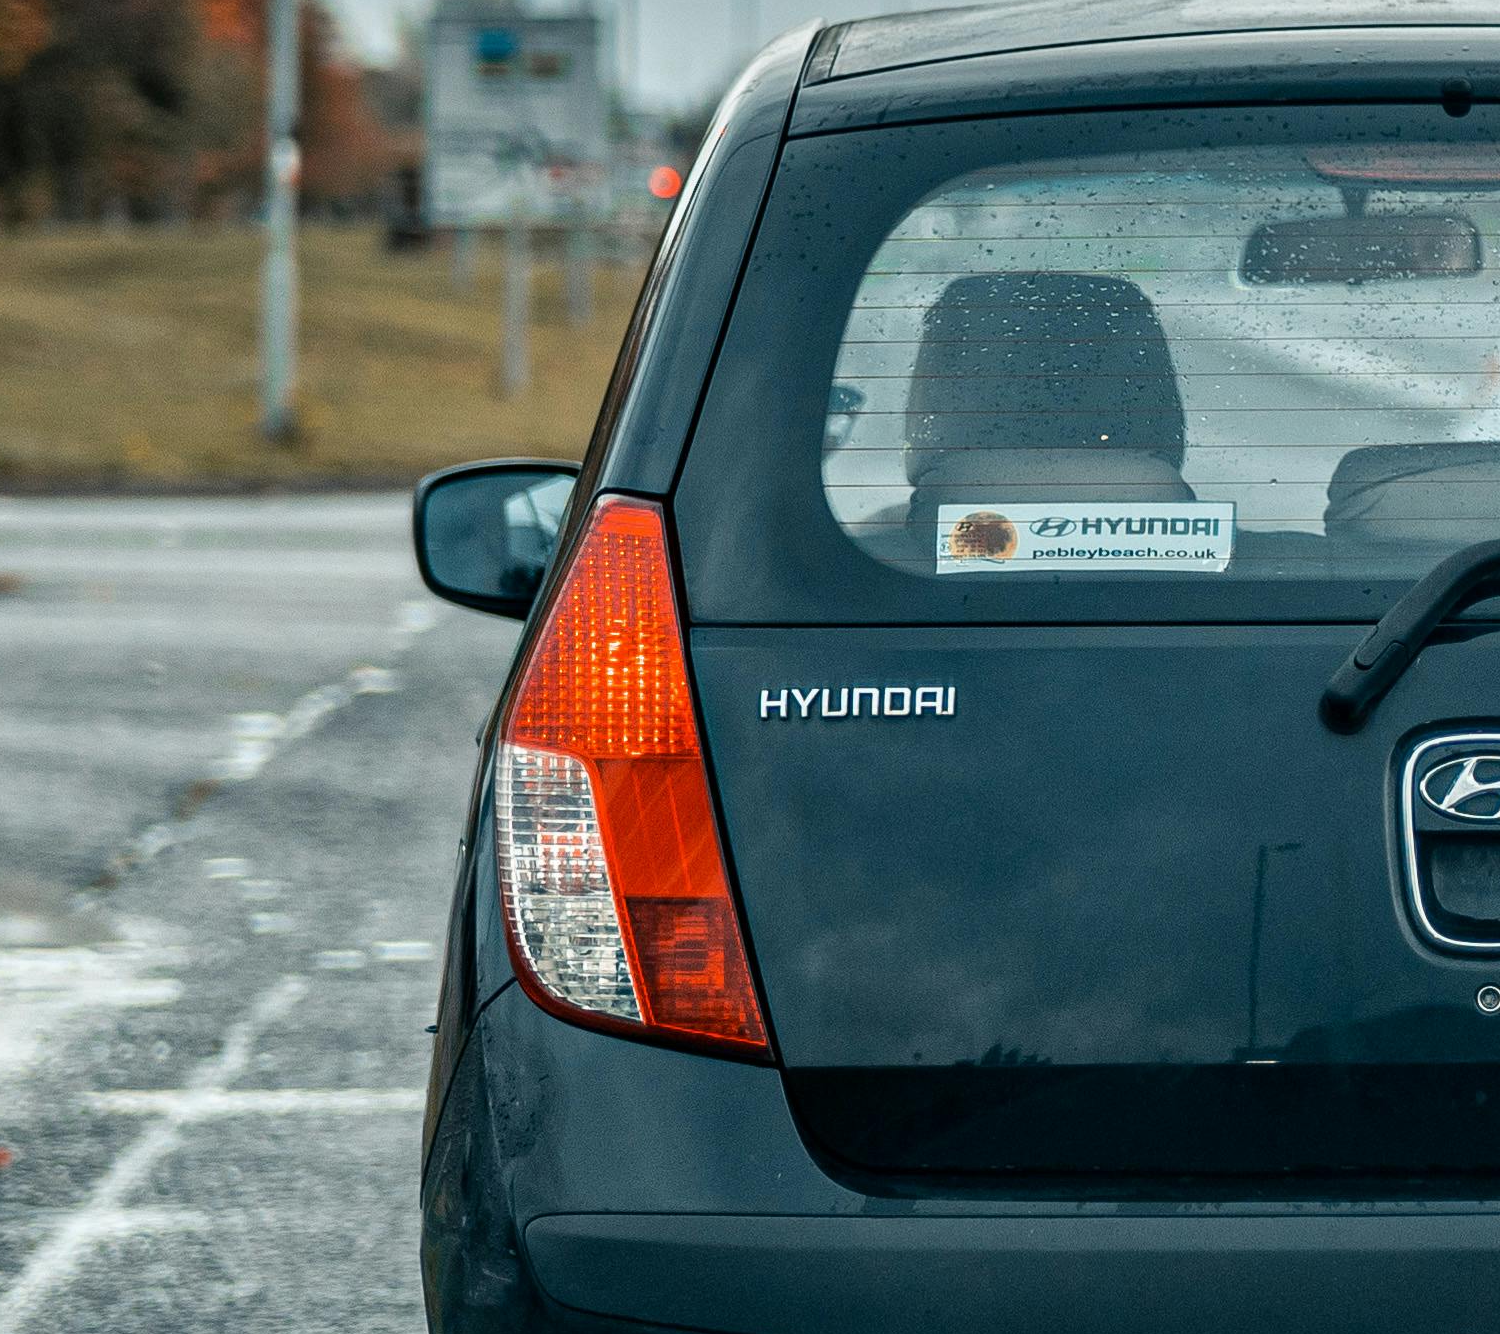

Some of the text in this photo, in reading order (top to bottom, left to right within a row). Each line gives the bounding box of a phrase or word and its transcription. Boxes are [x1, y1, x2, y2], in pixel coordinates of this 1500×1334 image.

[1081, 517, 1220, 536] HYUNDAI
[1032, 547, 1217, 560] pebleybeach.co.uk
[760, 686, 956, 718] HYUNDAI
